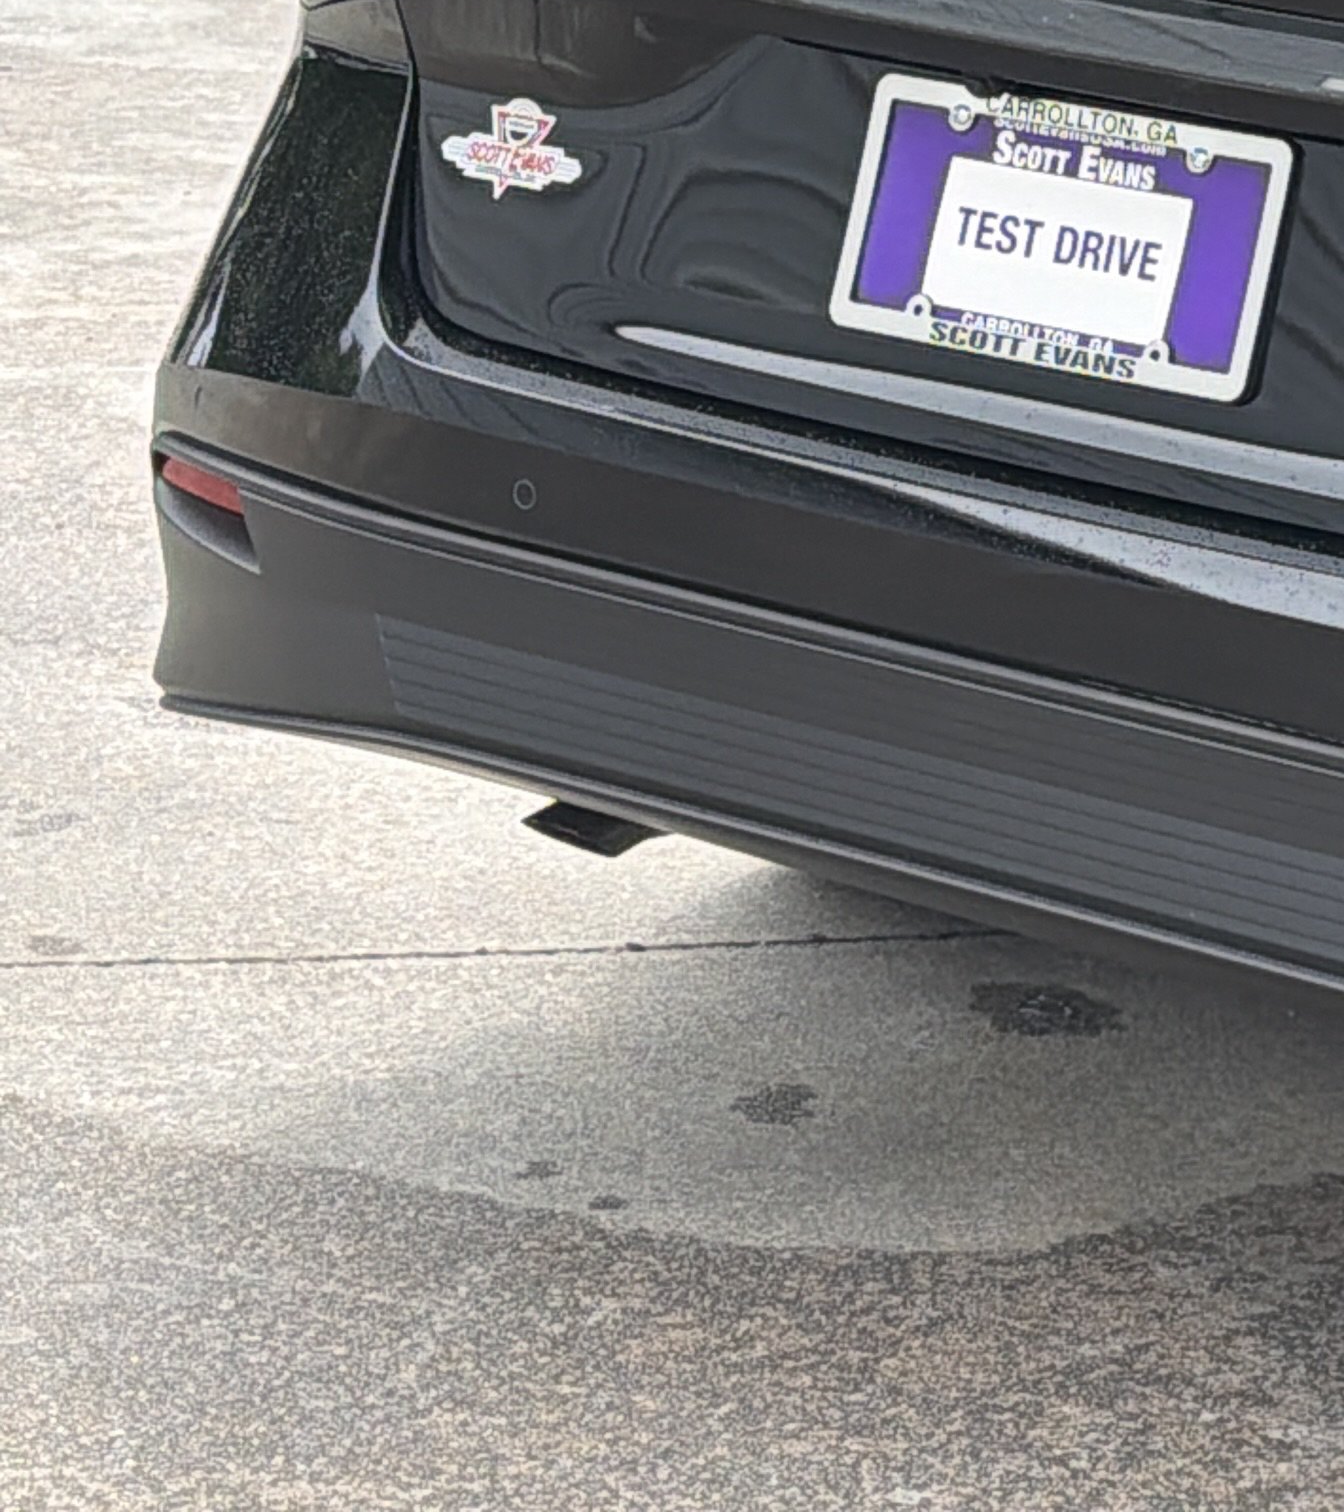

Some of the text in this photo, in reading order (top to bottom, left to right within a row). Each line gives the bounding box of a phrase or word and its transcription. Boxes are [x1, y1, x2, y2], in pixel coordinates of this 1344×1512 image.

[1147, 120, 1178, 145] GA
[957, 206, 1163, 282] TEST DRIVE
[929, 321, 1137, 379] SCOTT EVANS
